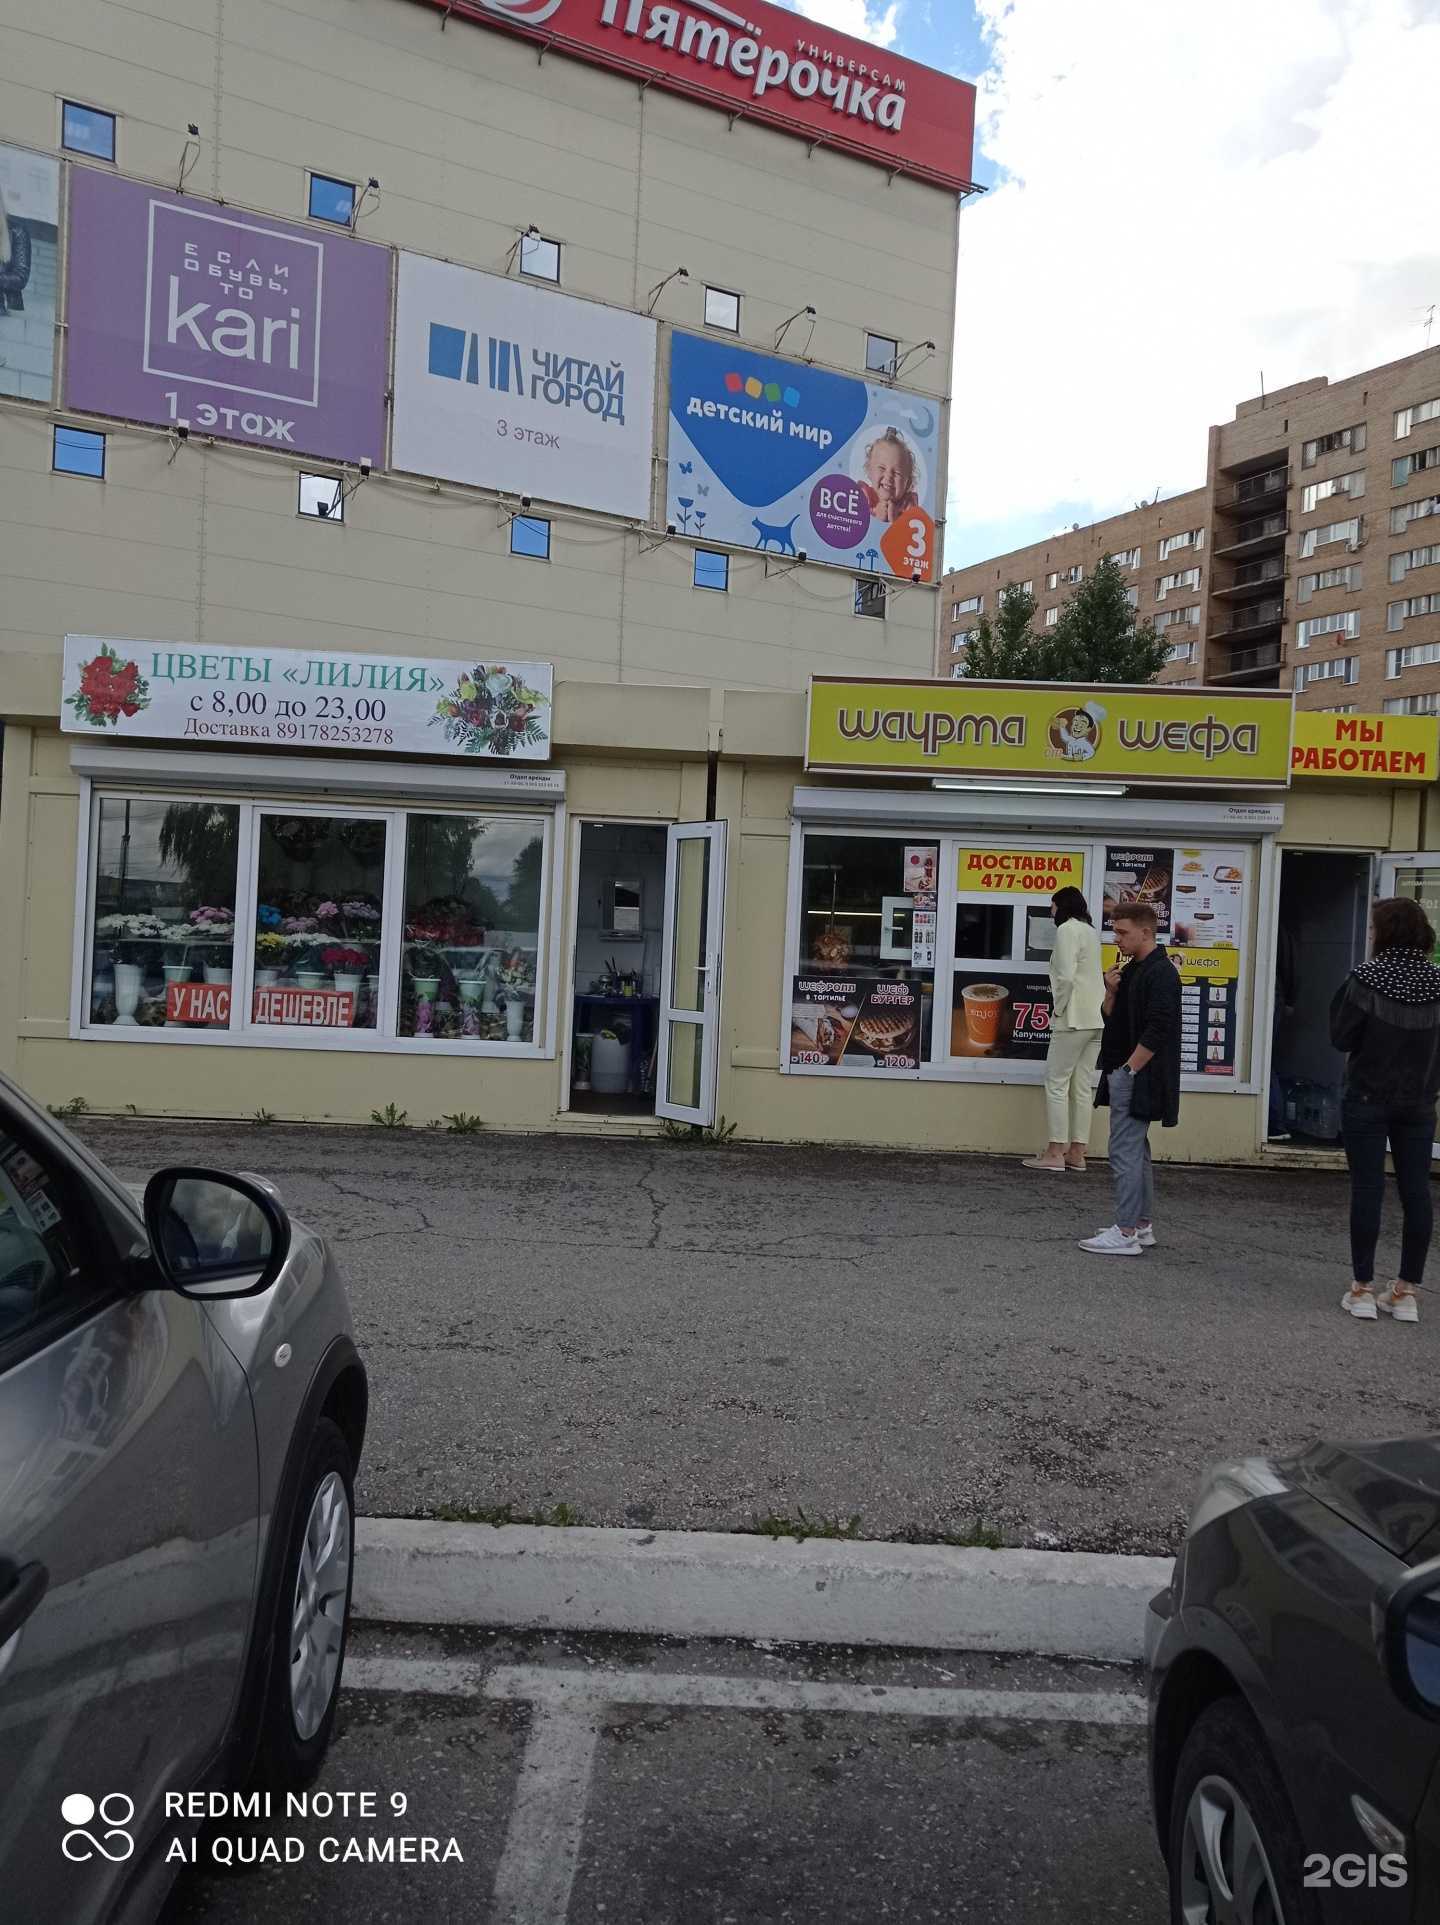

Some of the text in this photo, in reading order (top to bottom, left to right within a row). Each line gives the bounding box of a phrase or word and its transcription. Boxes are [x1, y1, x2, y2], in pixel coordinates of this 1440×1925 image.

[797, 39, 906, 92] УНИВЕРСАМ
[184, 258, 288, 295] ОБУВЬ,
[185, 242, 289, 278] ЕСЛИ
[219, 281, 253, 300] ТО
[167, 275, 300, 370] kari
[532, 348, 625, 395] ЧИТАЙ
[531, 374, 625, 426] ГОРОД
[165, 392, 295, 442] 1 этаж
[686, 396, 833, 450] детский мир
[496, 419, 560, 449] 3 этаж
[819, 487, 860, 516] ВСЁ
[906, 519, 926, 557] 3
[151, 652, 445, 693] ЦВЕТЫ «ЛИЛИЯ»
[190, 690, 386, 722] с 8,00 до 23,00
[184, 718, 394, 745] Доставка 89178253278
[1336, 719, 1384, 743] МЫ
[1291, 747, 1426, 774] РАБОТАЕМ
[967, 854, 1073, 872] ДОСТАВКА
[981, 873, 1058, 890] 477-000
[173, 987, 229, 1021] У НАС
[255, 992, 350, 1027] ДЕШЕВЛЕ
[870, 994, 914, 1005] БУРГЕР
[1012, 1003, 1050, 1030] 75
[1012, 1030, 1051, 1039] Капучин
